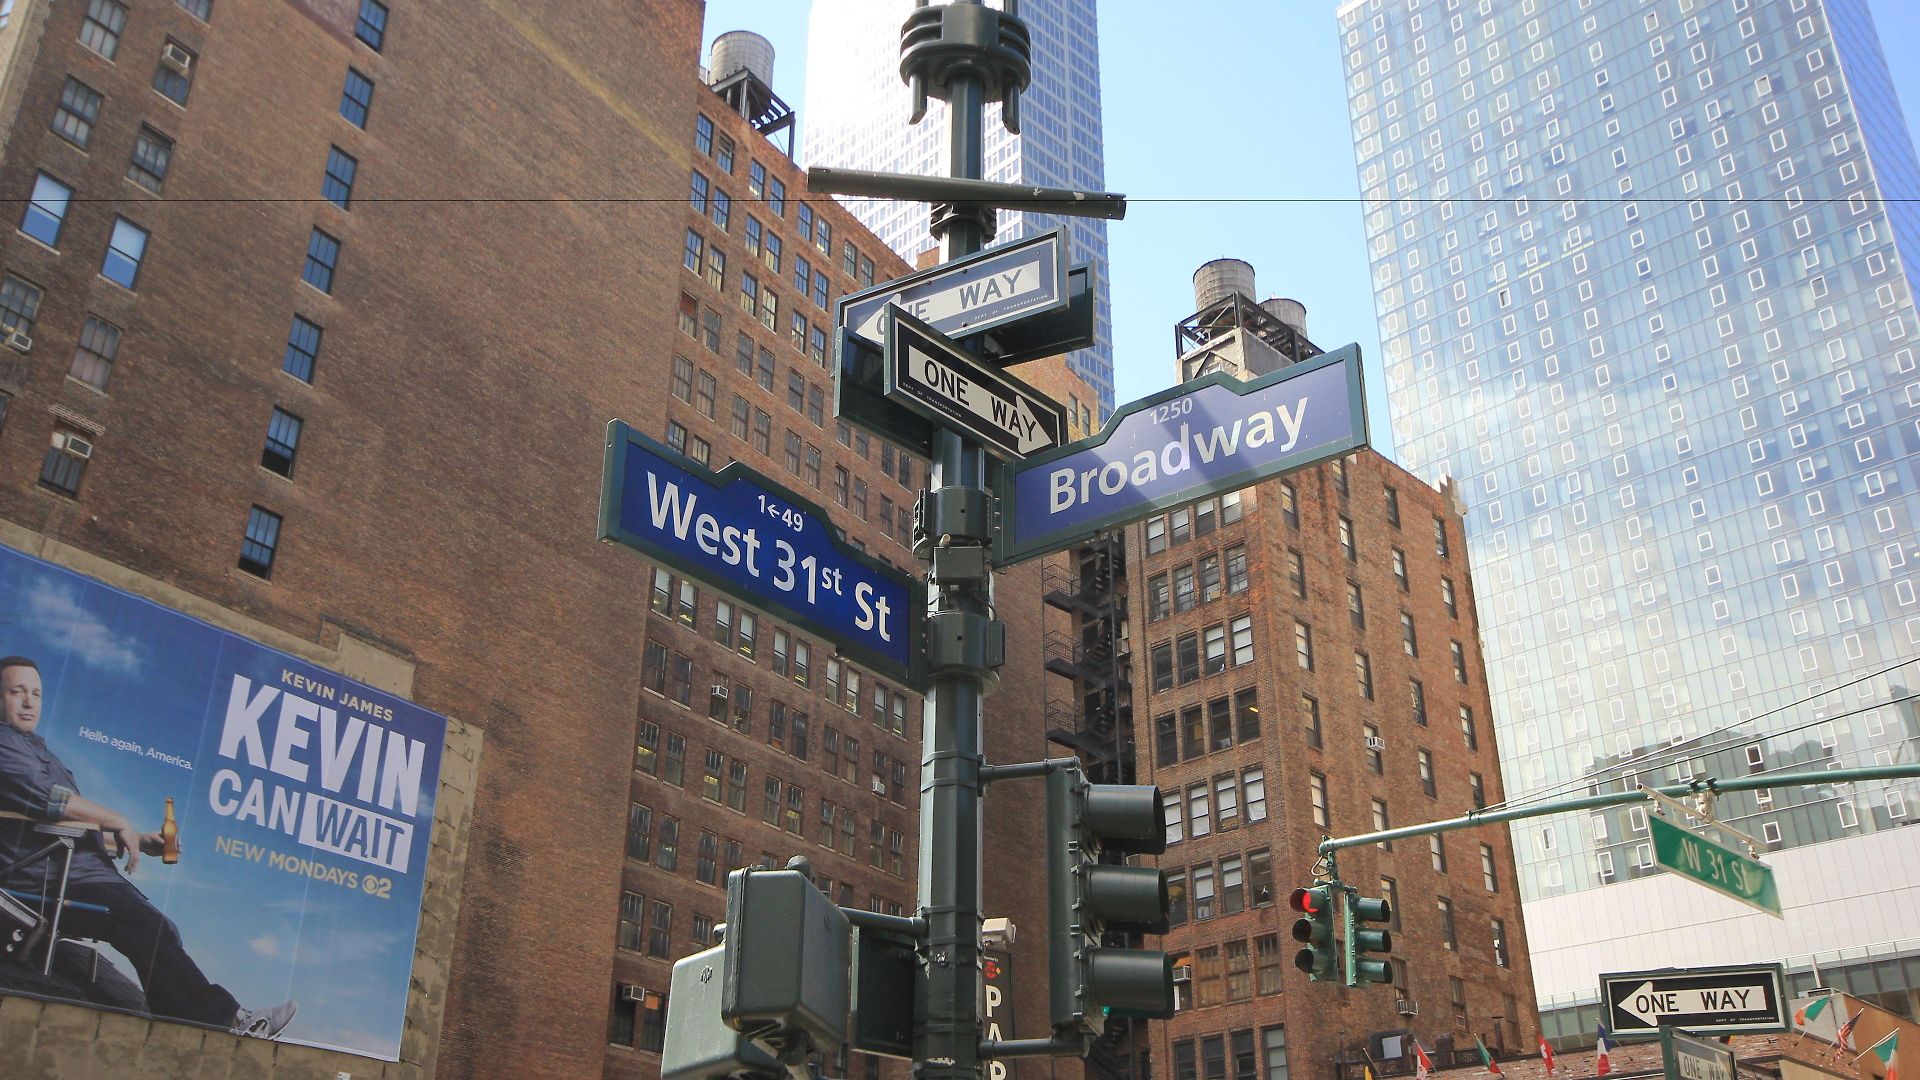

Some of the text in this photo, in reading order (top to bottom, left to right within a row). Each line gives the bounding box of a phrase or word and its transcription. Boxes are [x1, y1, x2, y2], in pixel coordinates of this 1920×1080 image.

[959, 269, 1022, 310] WAY
[925, 360, 1036, 442] ONE WAY
[1150, 397, 1193, 426] 1250
[1050, 397, 1308, 515] Broadway
[647, 471, 892, 642] West 31st St
[281, 669, 393, 721] KEVIN JAMES
[79, 726, 193, 770] Hello again, America.
[218, 673, 426, 818] KEVIN
[209, 768, 405, 866] CAN WAIT
[215, 836, 265, 863] NEW
[268, 850, 358, 889] MONDAYS
[1682, 838, 1753, 895] W 31 St
[1635, 989, 1750, 1014] ONE WAY
[1683, 1055, 1703, 1080] ONE
